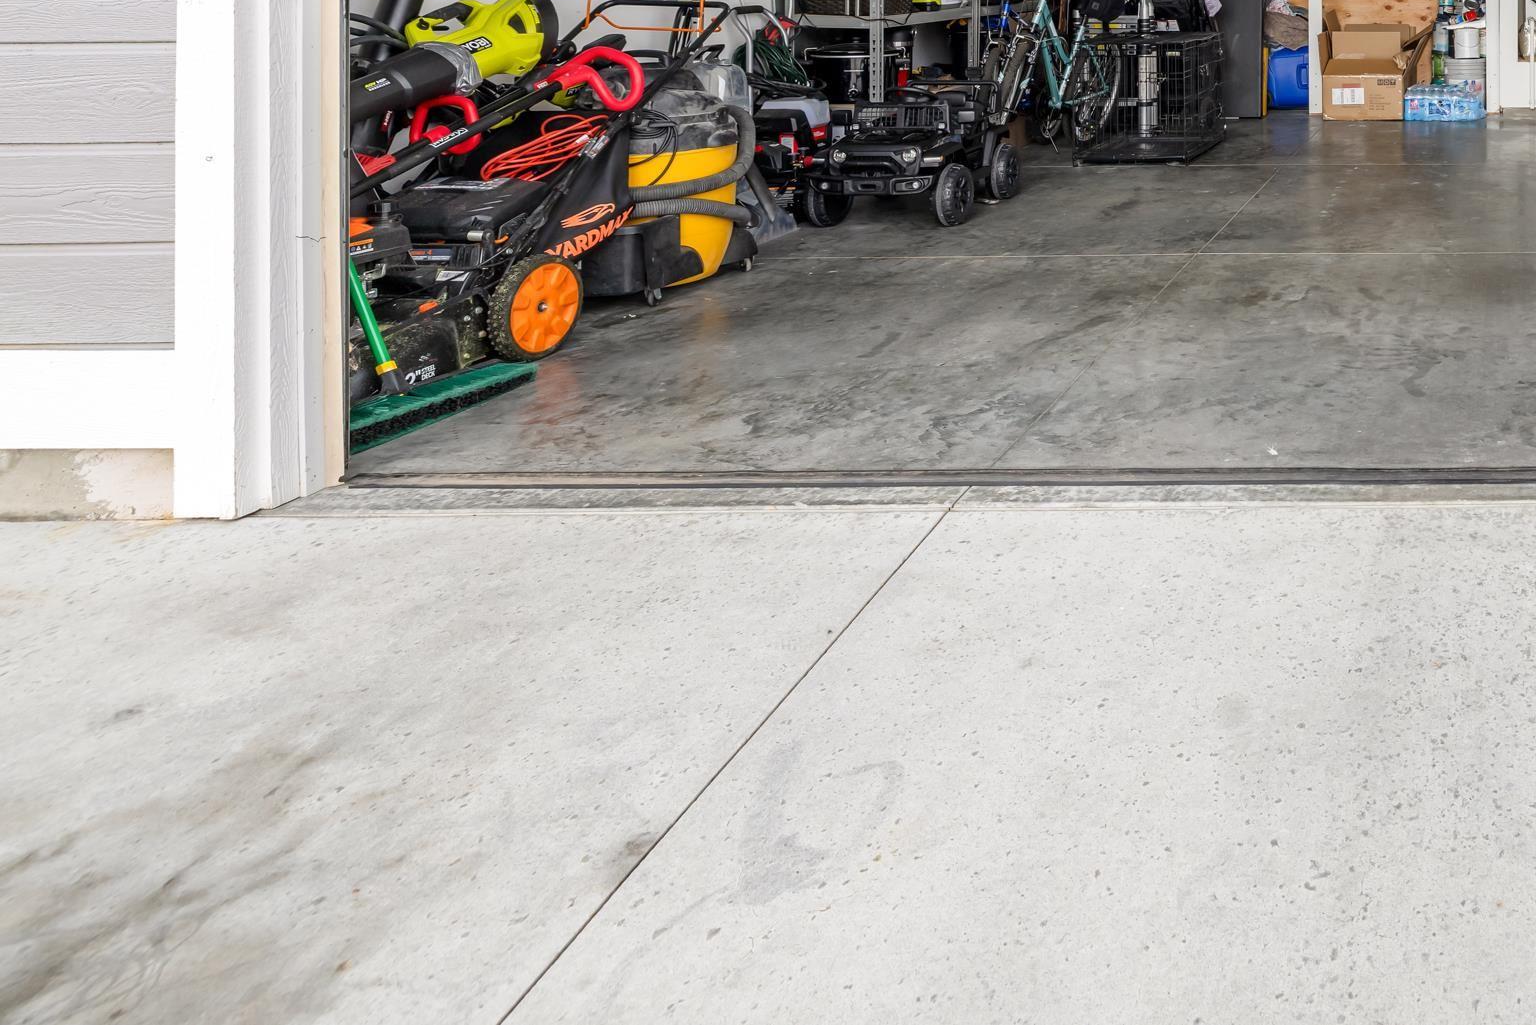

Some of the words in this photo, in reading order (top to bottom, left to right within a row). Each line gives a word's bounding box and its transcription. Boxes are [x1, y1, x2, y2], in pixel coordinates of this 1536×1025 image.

[462, 36, 491, 52] YOBI
[543, 205, 636, 260] YARDMAX
[420, 369, 437, 382] DECK
[421, 363, 437, 376] STEEL
